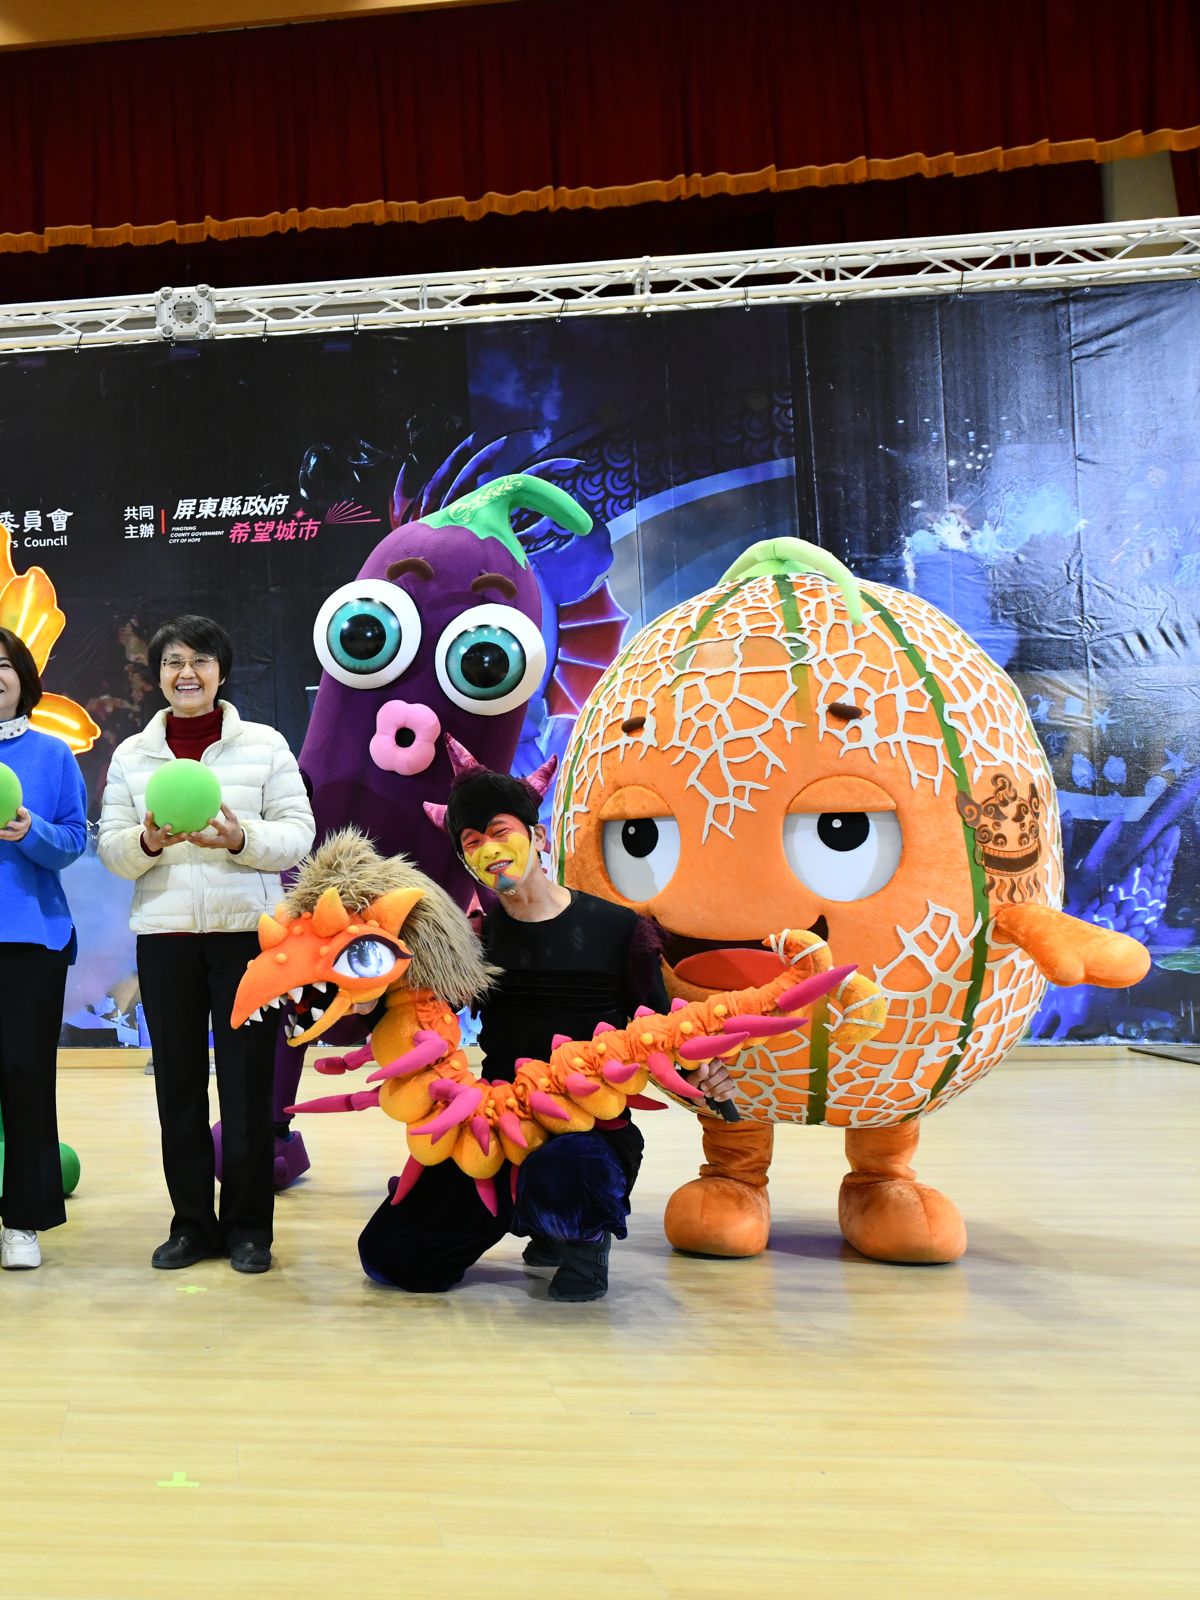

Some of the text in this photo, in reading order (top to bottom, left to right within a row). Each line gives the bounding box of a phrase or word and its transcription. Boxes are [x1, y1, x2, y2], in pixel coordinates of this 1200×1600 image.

[124, 505, 154, 521] 共同
[172, 494, 290, 520] 屏東縣政府
[124, 523, 154, 539] 主辦
[229, 518, 322, 544] 希望城市
[23, 535, 68, 548] Council
